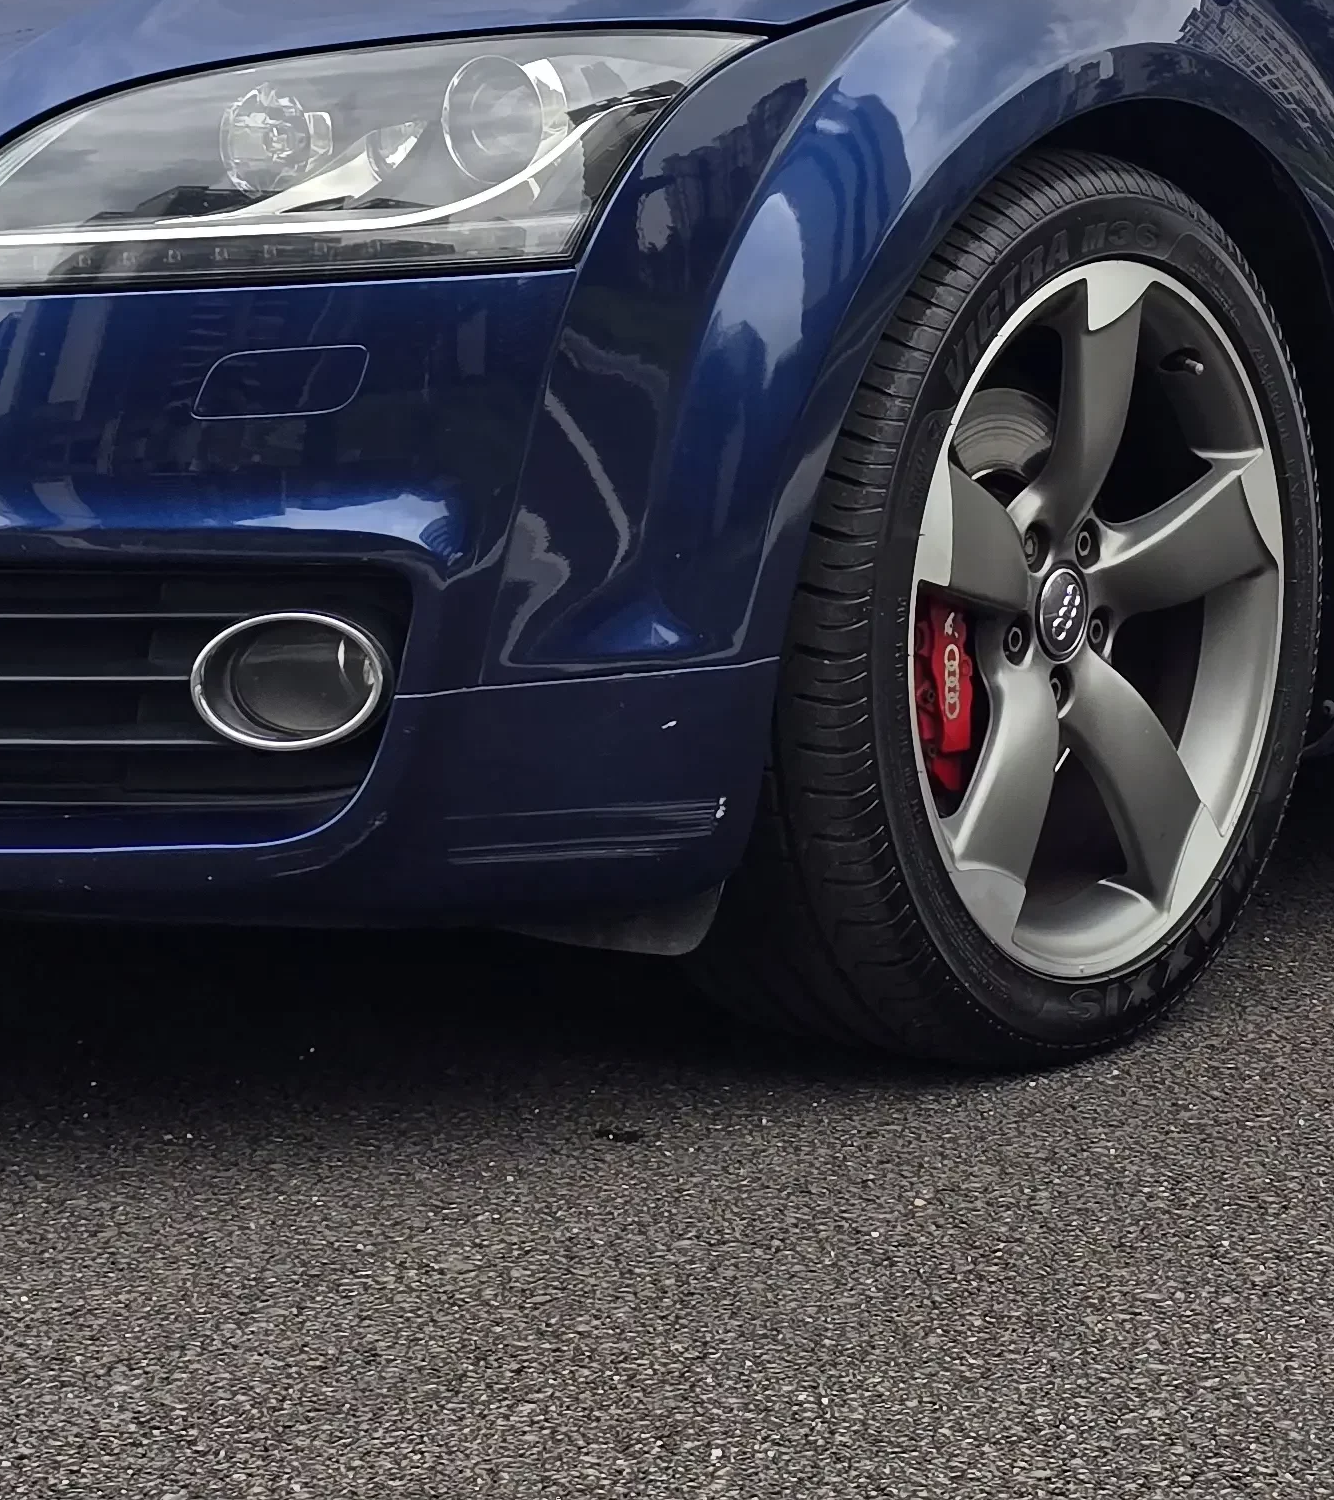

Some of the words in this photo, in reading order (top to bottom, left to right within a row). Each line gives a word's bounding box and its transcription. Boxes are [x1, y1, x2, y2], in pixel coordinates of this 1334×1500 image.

[943, 227, 1070, 395] VICTRA
[1081, 219, 1162, 254] M36
[1067, 822, 1256, 1021] MAXXIS
